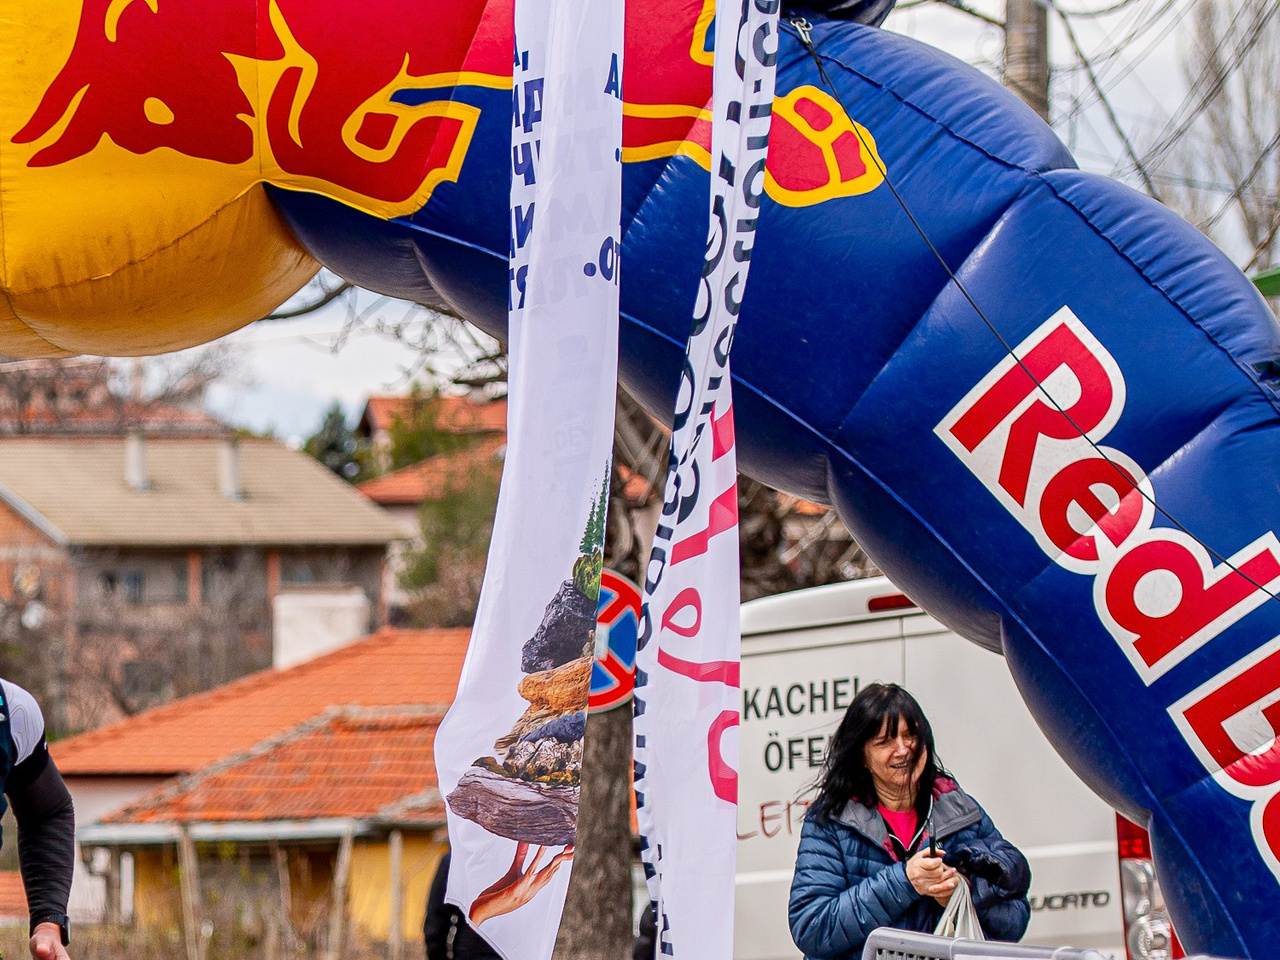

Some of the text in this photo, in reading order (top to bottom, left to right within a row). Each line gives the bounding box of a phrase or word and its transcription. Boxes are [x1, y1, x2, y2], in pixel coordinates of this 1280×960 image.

[936, 308, 1280, 684] Red
[764, 731, 836, 772] ÖFE
[1030, 892, 1109, 911] UCATO
